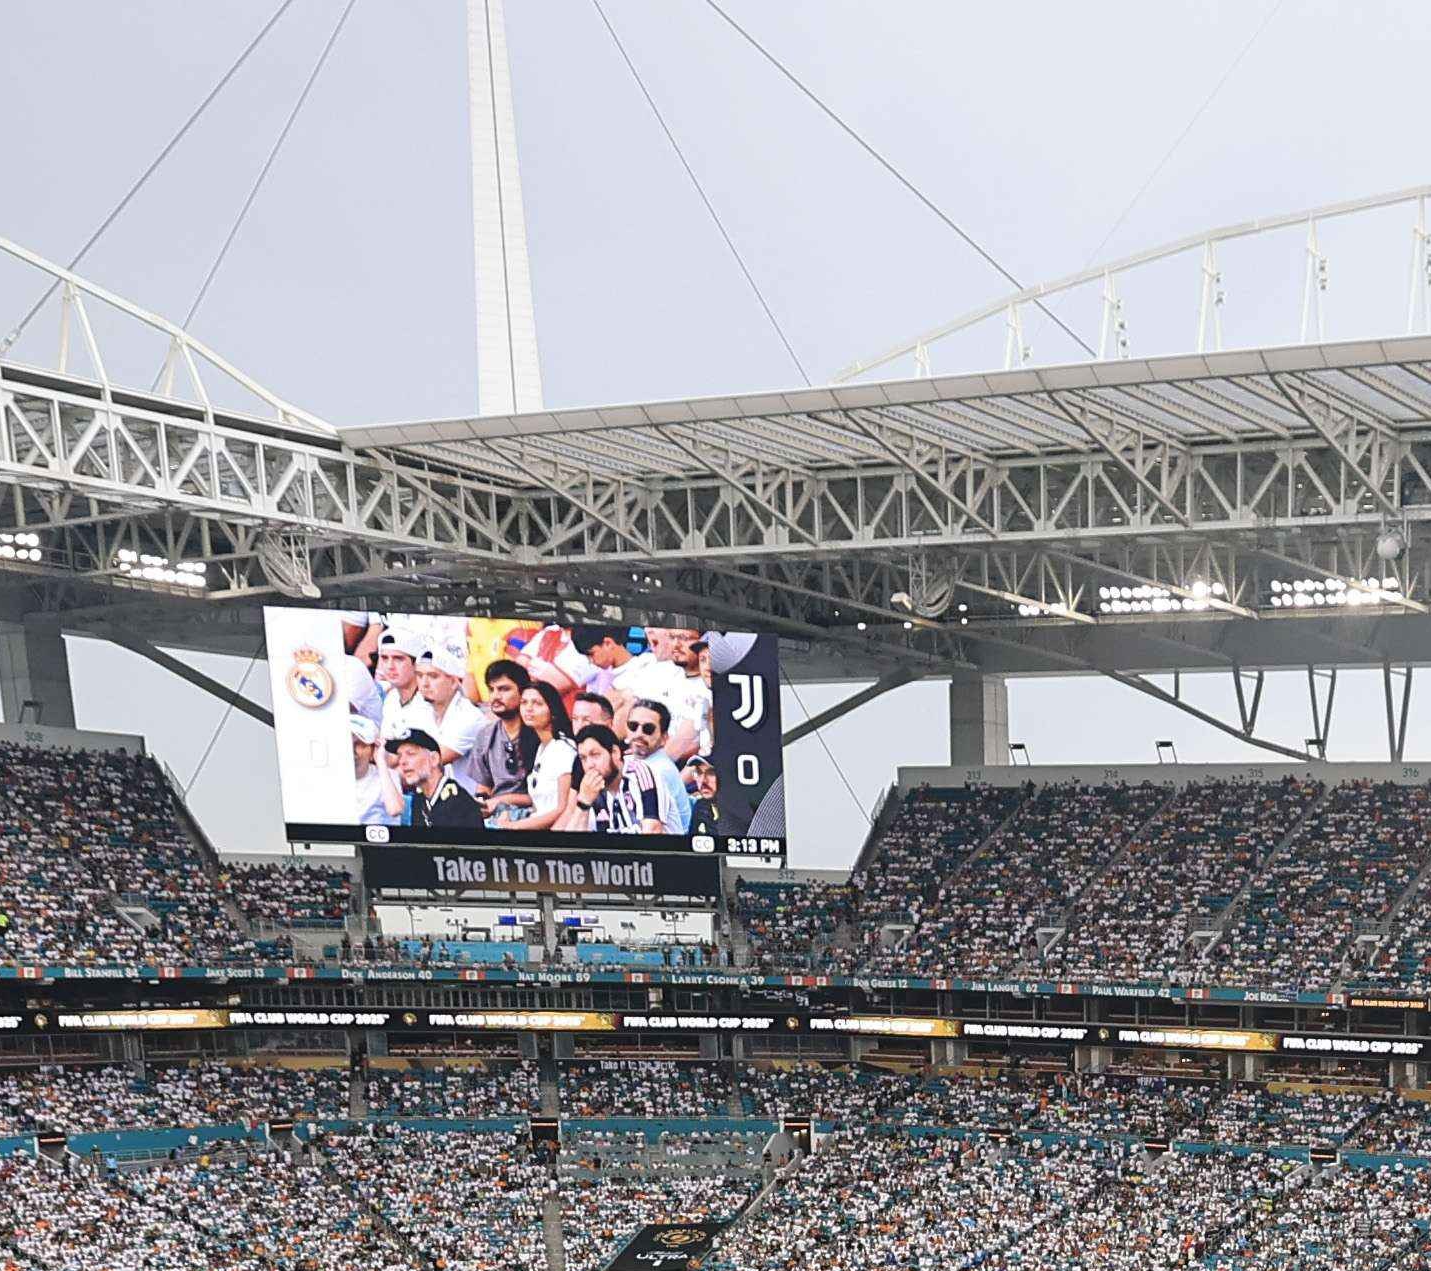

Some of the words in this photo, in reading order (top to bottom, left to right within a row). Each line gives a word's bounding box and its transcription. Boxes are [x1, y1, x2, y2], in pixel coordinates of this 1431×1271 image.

[736, 754, 760, 786] 0
[1402, 767, 1419, 777] 316
[727, 838, 757, 853] 3:13
[759, 840, 780, 854] PM
[433, 856, 487, 882] Take
[492, 858, 508, 883] It
[514, 858, 538, 884] To
[544, 859, 585, 885] The
[588, 860, 654, 887] World
[418, 968, 433, 981] 40
[575, 972, 590, 982] 89
[751, 975, 765, 986] 39
[1025, 982, 1038, 993] 62
